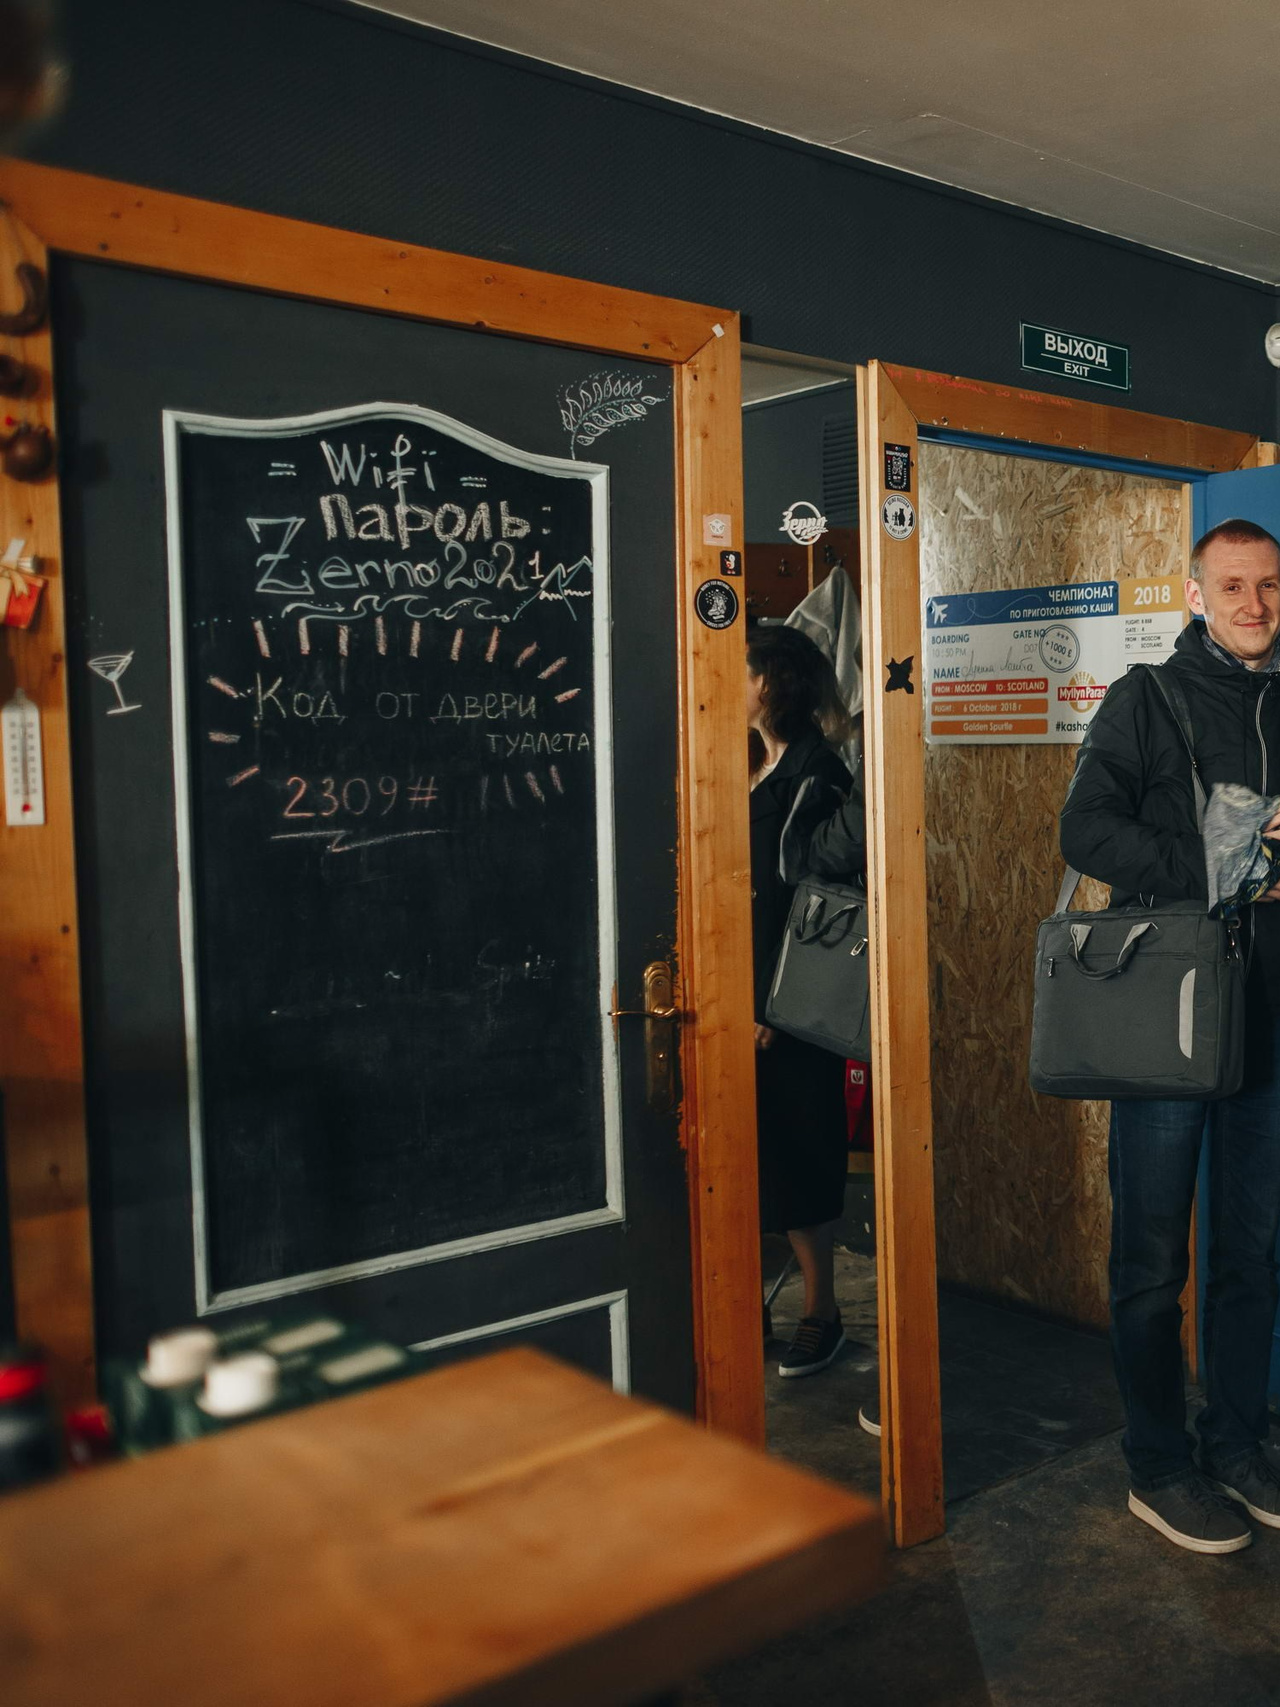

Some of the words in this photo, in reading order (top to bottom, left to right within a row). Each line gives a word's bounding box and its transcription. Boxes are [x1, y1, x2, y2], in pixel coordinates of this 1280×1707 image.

[1044, 332, 1108, 367] ВЫХОД
[1064, 361, 1090, 377] EXIT
[1048, 585, 1114, 603] ЧЕМПИОНАТ
[1133, 584, 1171, 606] 2018
[1009, 610, 1021, 619] ПО
[1022, 605, 1089, 618] ПРИГОТОВЛЕНИЮ
[1089, 603, 1114, 613] КАШИ
[931, 634, 970, 645] BOARDING
[1013, 630, 1032, 639] GATE
[933, 667, 960, 679] NAME
[954, 683, 987, 693] MOSCOW
[1007, 681, 1045, 691] SCOTLAND
[256, 672, 348, 727] Код
[963, 704, 968, 712] 6
[969, 703, 997, 712] October
[1000, 702, 1017, 711] 2018
[962, 722, 989, 732] Golden
[283, 776, 439, 817] 2309#
